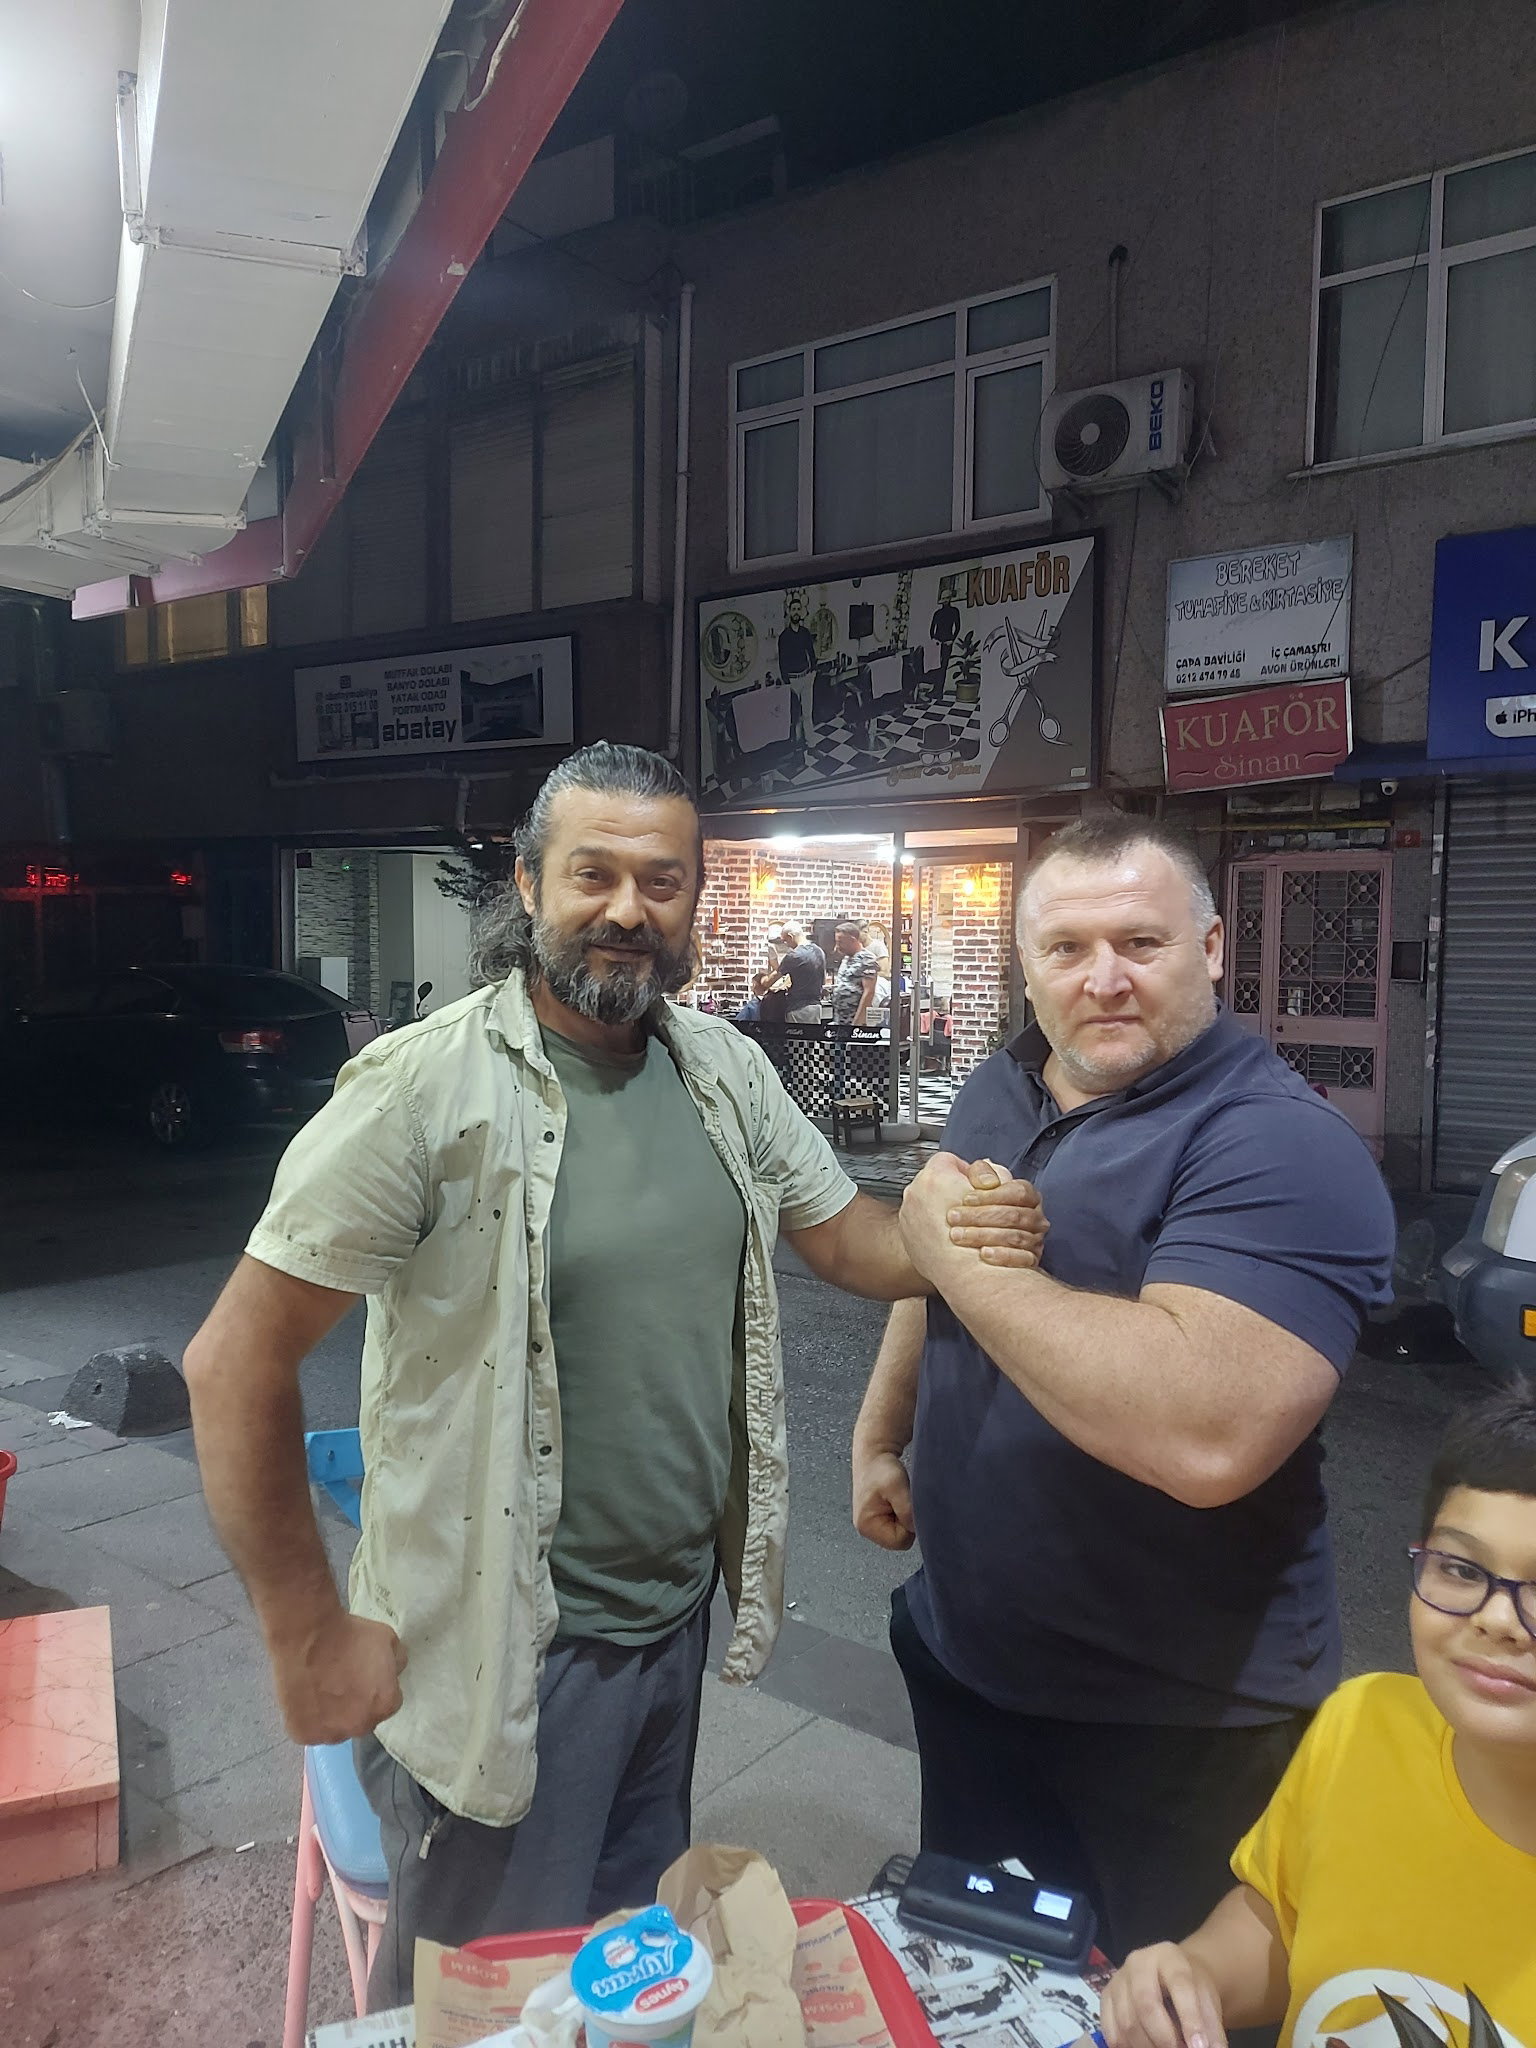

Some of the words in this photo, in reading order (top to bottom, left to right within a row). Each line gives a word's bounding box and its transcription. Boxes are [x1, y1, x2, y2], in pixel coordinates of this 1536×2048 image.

[1148, 380, 1164, 451] BEKO
[966, 550, 1070, 609] KUAFÖR
[1216, 551, 1301, 586] BEREKET
[1174, 590, 1248, 622] TUHAFİYE
[1249, 596, 1261, 612] &
[1262, 576, 1344, 611] KIRTASİYE
[1271, 646, 1282, 660] İÇ
[1284, 642, 1331, 659] ÇAMAŞIRI
[420, 664, 452, 676] DOLABI
[1176, 657, 1201, 672] ÇAPA
[1260, 658, 1287, 676] AVON
[1290, 654, 1340, 672] ÜRÜNLERİ
[387, 680, 417, 692] BANYO
[418, 677, 450, 688] DOLABI
[1176, 672, 1196, 684] 0212
[391, 692, 419, 704] YATAK
[421, 690, 447, 700] ODASI
[382, 716, 457, 742] abatay
[1176, 692, 1340, 752] KUAFÖR
[1214, 753, 1301, 780] Sinan
[850, 1027, 880, 1038] Sinan
[591, 1940, 678, 1998] Ayran
